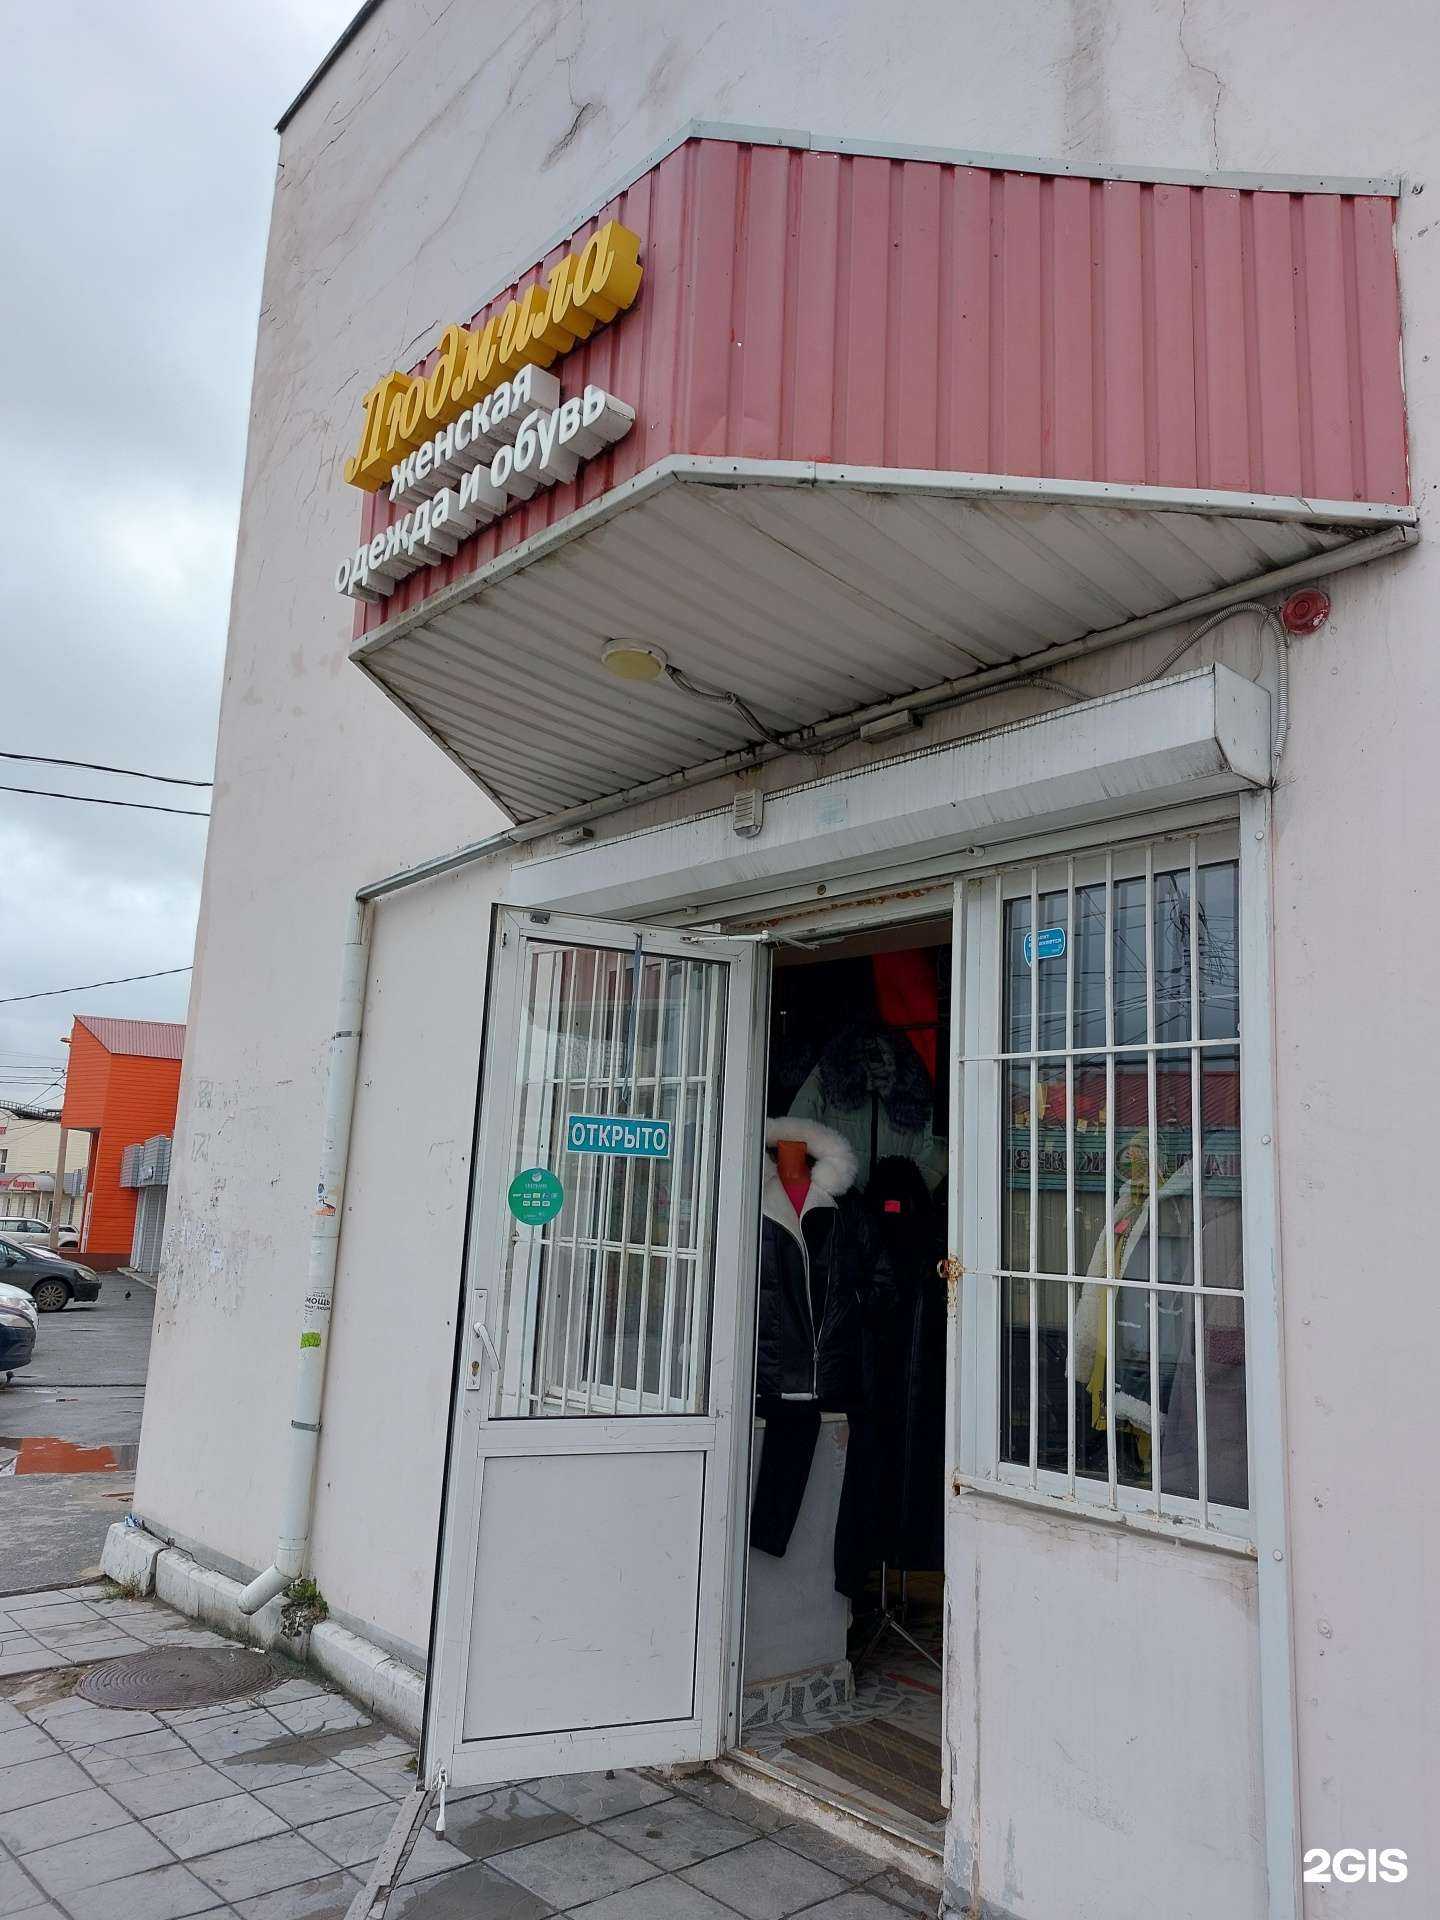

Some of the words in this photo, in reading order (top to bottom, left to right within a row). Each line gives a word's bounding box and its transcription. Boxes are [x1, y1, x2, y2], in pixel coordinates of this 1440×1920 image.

[345, 219, 616, 485] Людмила
[389, 364, 534, 501] женская
[334, 487, 450, 594] одежда
[458, 465, 481, 511] и
[490, 384, 607, 488] обувь
[571, 1122, 667, 1151] ОТКРЫТО
